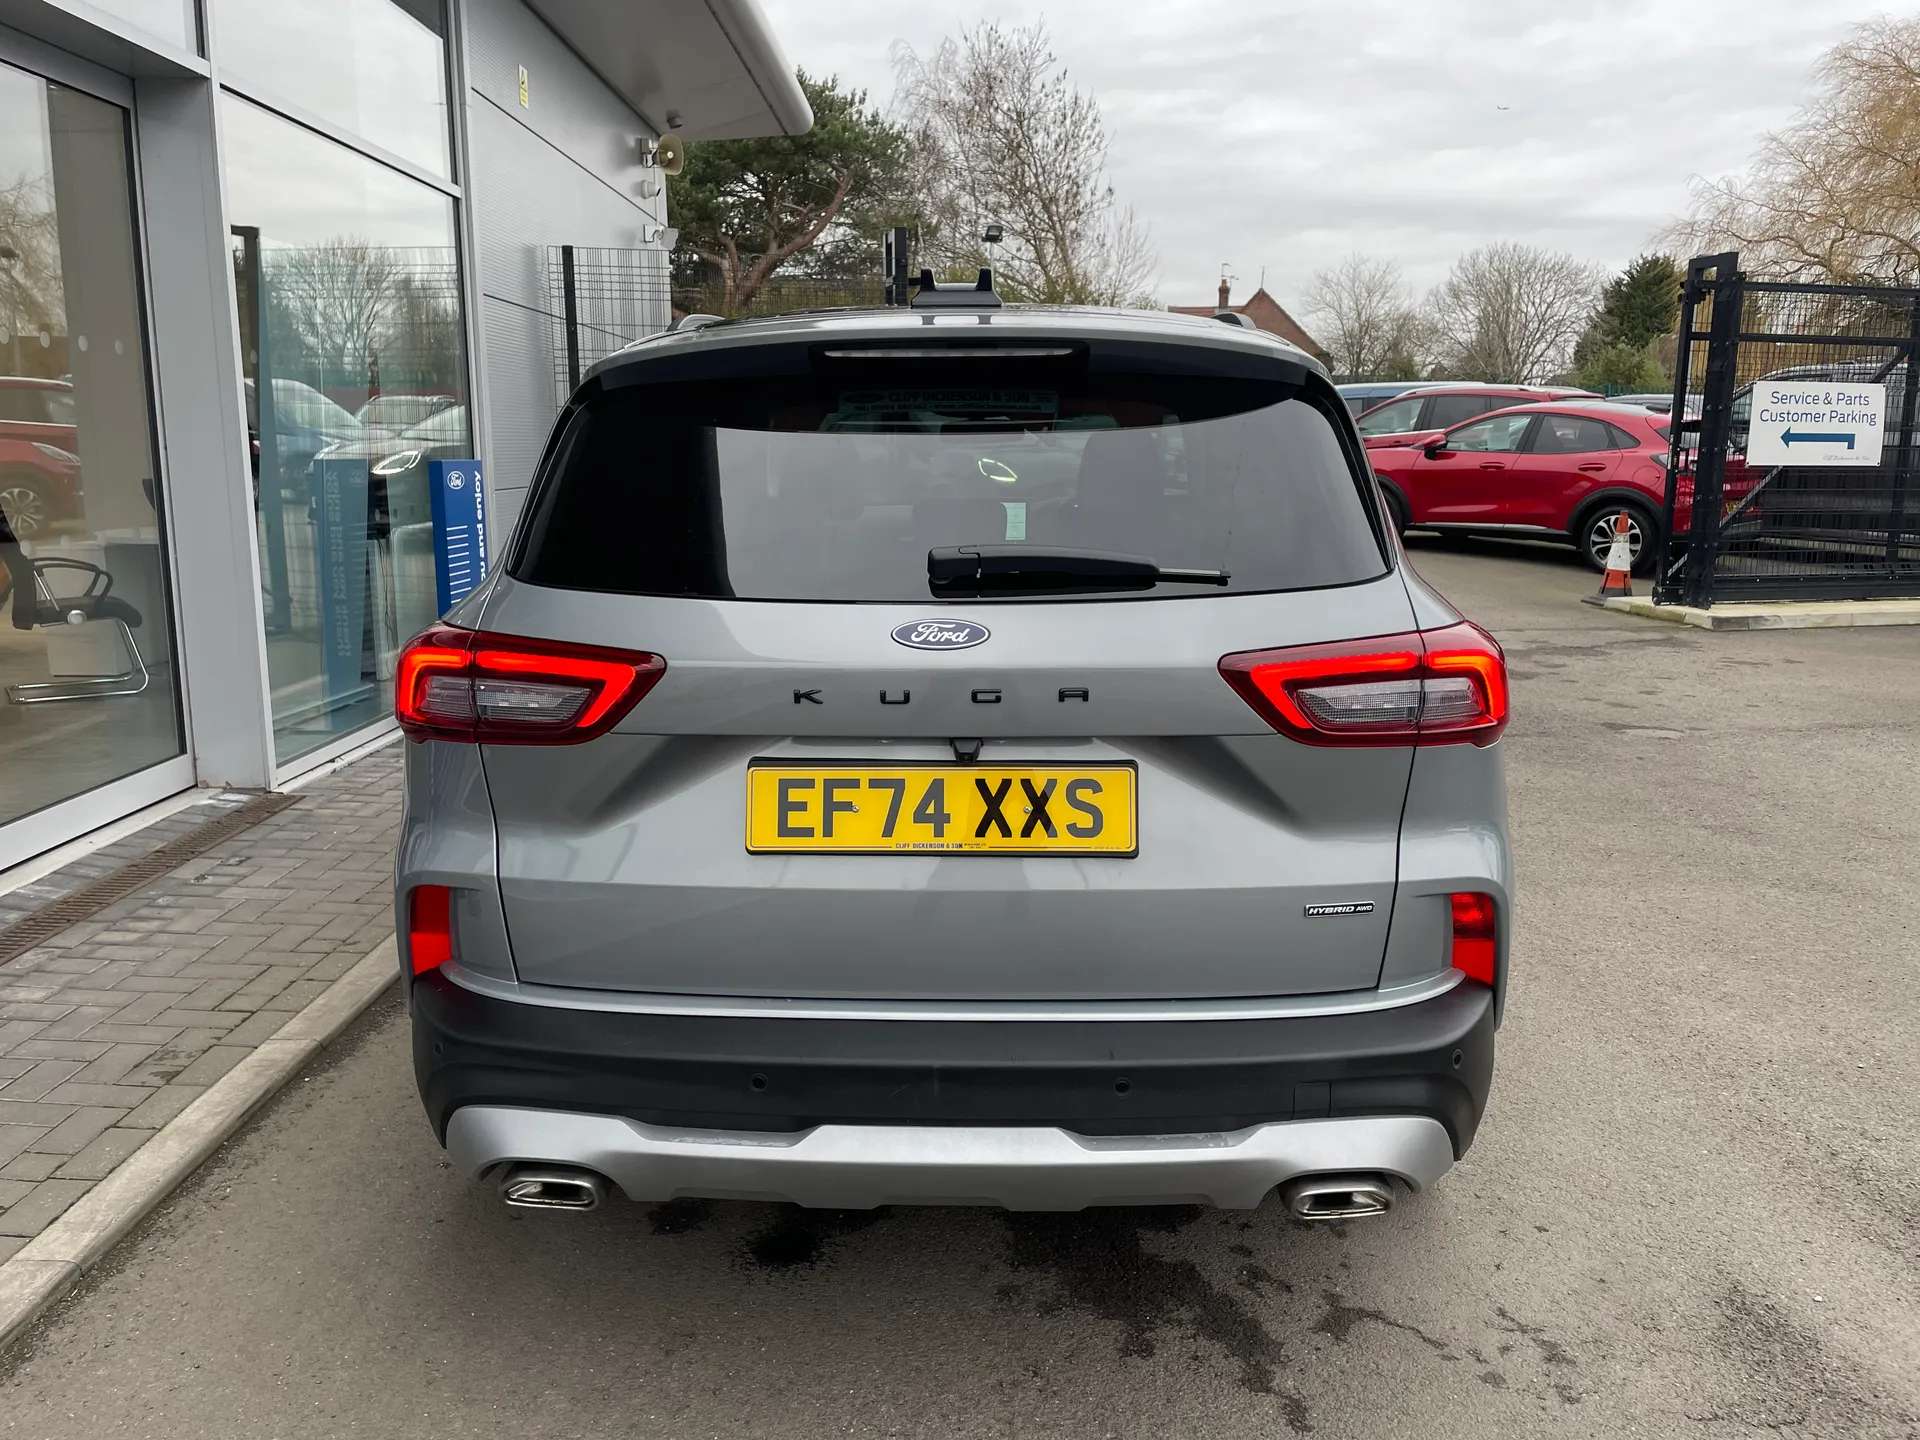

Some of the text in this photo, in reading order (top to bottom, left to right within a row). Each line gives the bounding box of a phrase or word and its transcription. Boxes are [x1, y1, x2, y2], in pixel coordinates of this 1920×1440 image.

[1770, 391, 1870, 406] Service & Parts
[1759, 409, 1877, 426] Customer Parking
[474, 470, 483, 521] enjoy
[476, 525, 485, 558] and
[910, 622, 970, 644] Ford
[793, 687, 1089, 704] KUGA
[777, 777, 1104, 839] EF74 XXS
[1309, 906, 1354, 914] HYBRID
